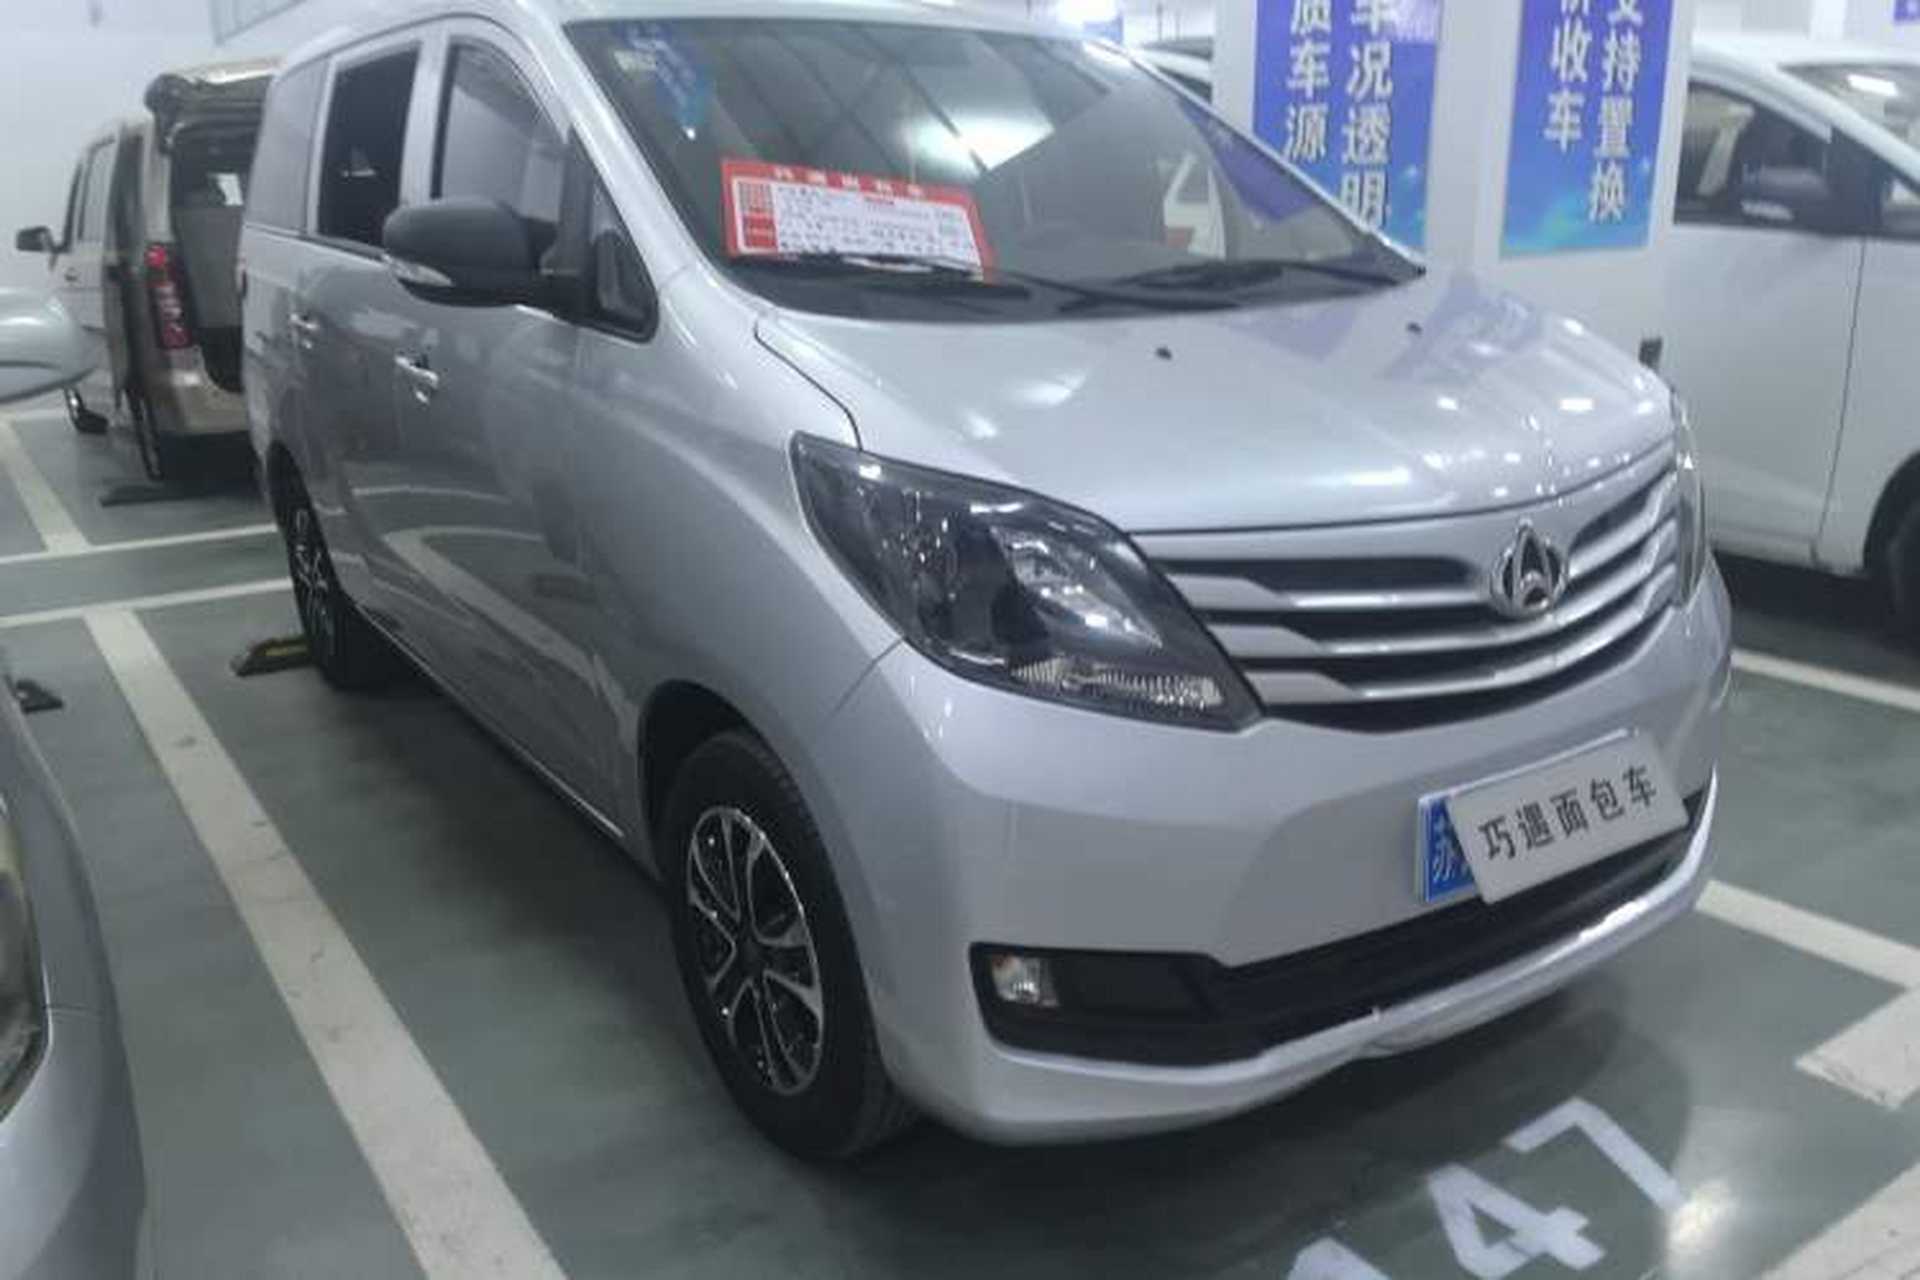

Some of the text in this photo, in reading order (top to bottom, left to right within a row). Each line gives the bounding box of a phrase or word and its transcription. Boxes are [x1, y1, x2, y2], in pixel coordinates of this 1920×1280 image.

[1544, 0, 1592, 152] 收车
[1477, 764, 1657, 860] 巧遇面包车
